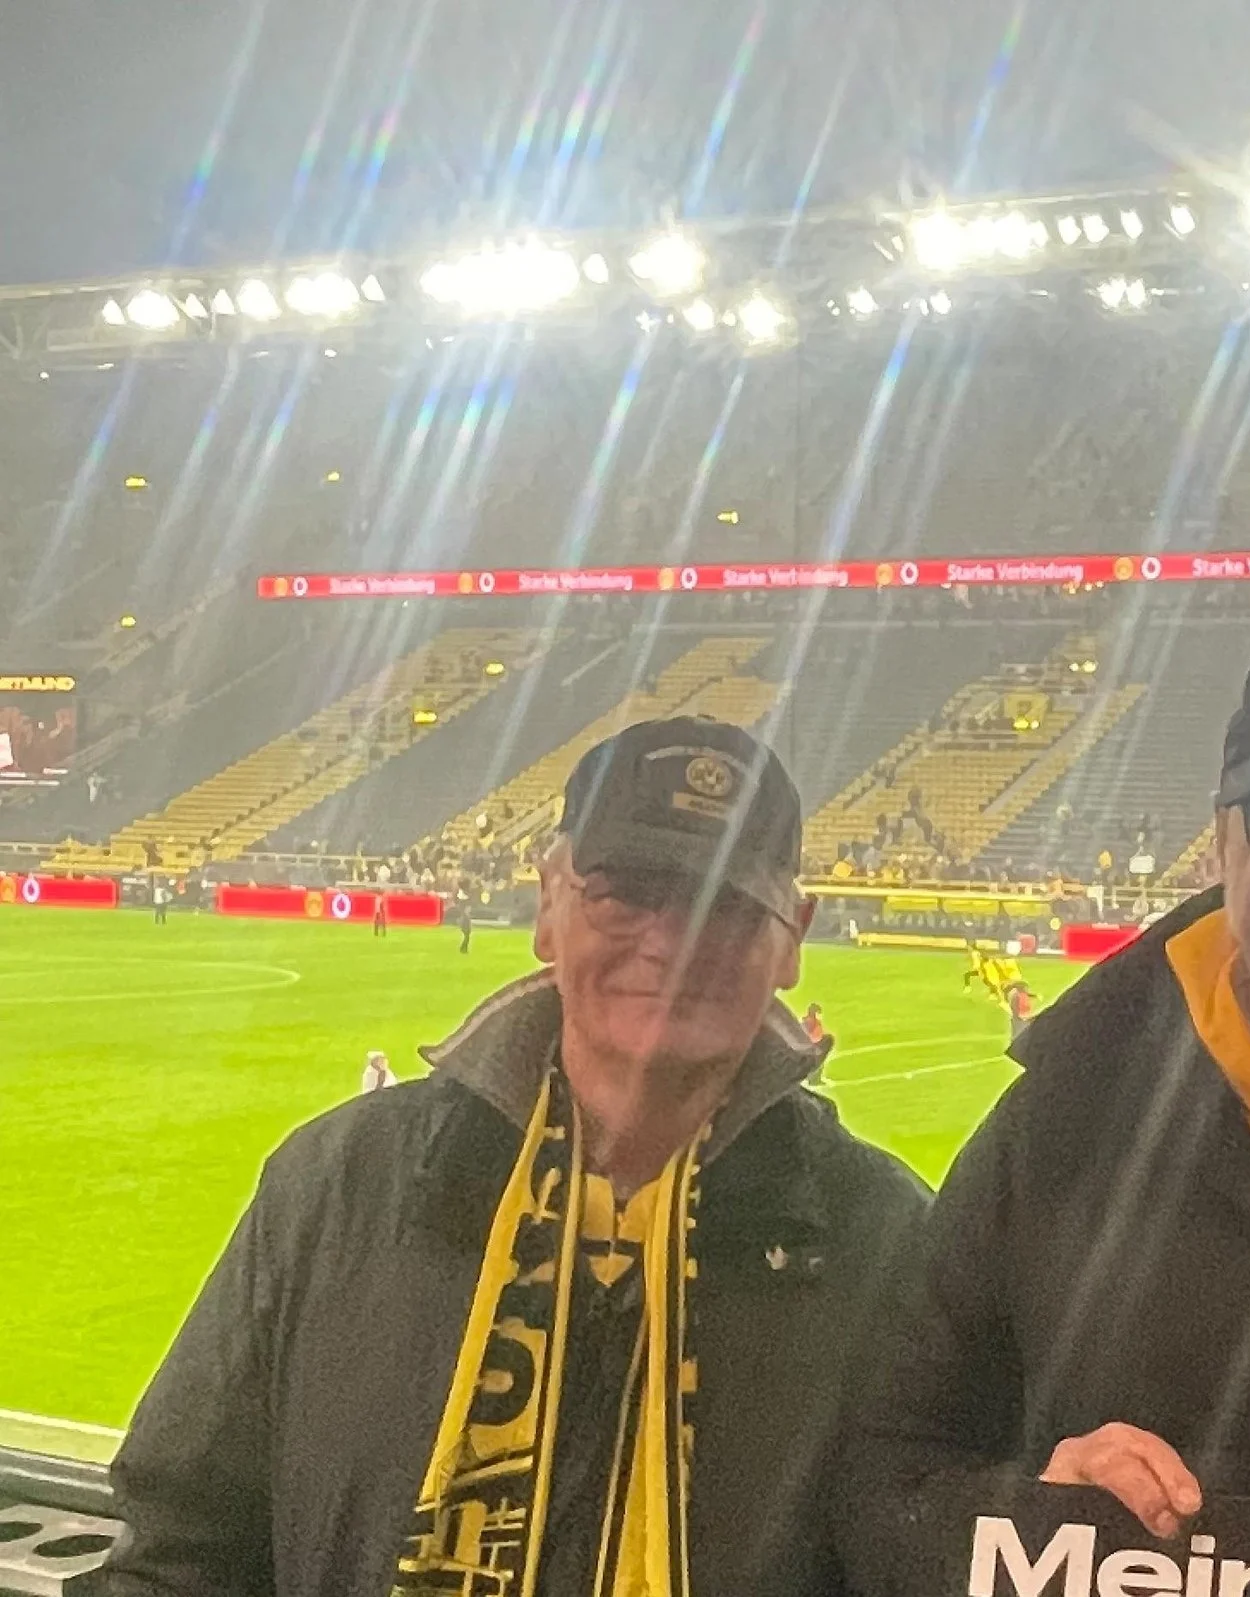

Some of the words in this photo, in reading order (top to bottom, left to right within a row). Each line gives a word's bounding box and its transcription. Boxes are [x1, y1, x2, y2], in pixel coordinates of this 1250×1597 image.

[947, 565, 994, 581] Starke
[997, 562, 1083, 582] Verbindung
[1192, 558, 1243, 576] Starke
